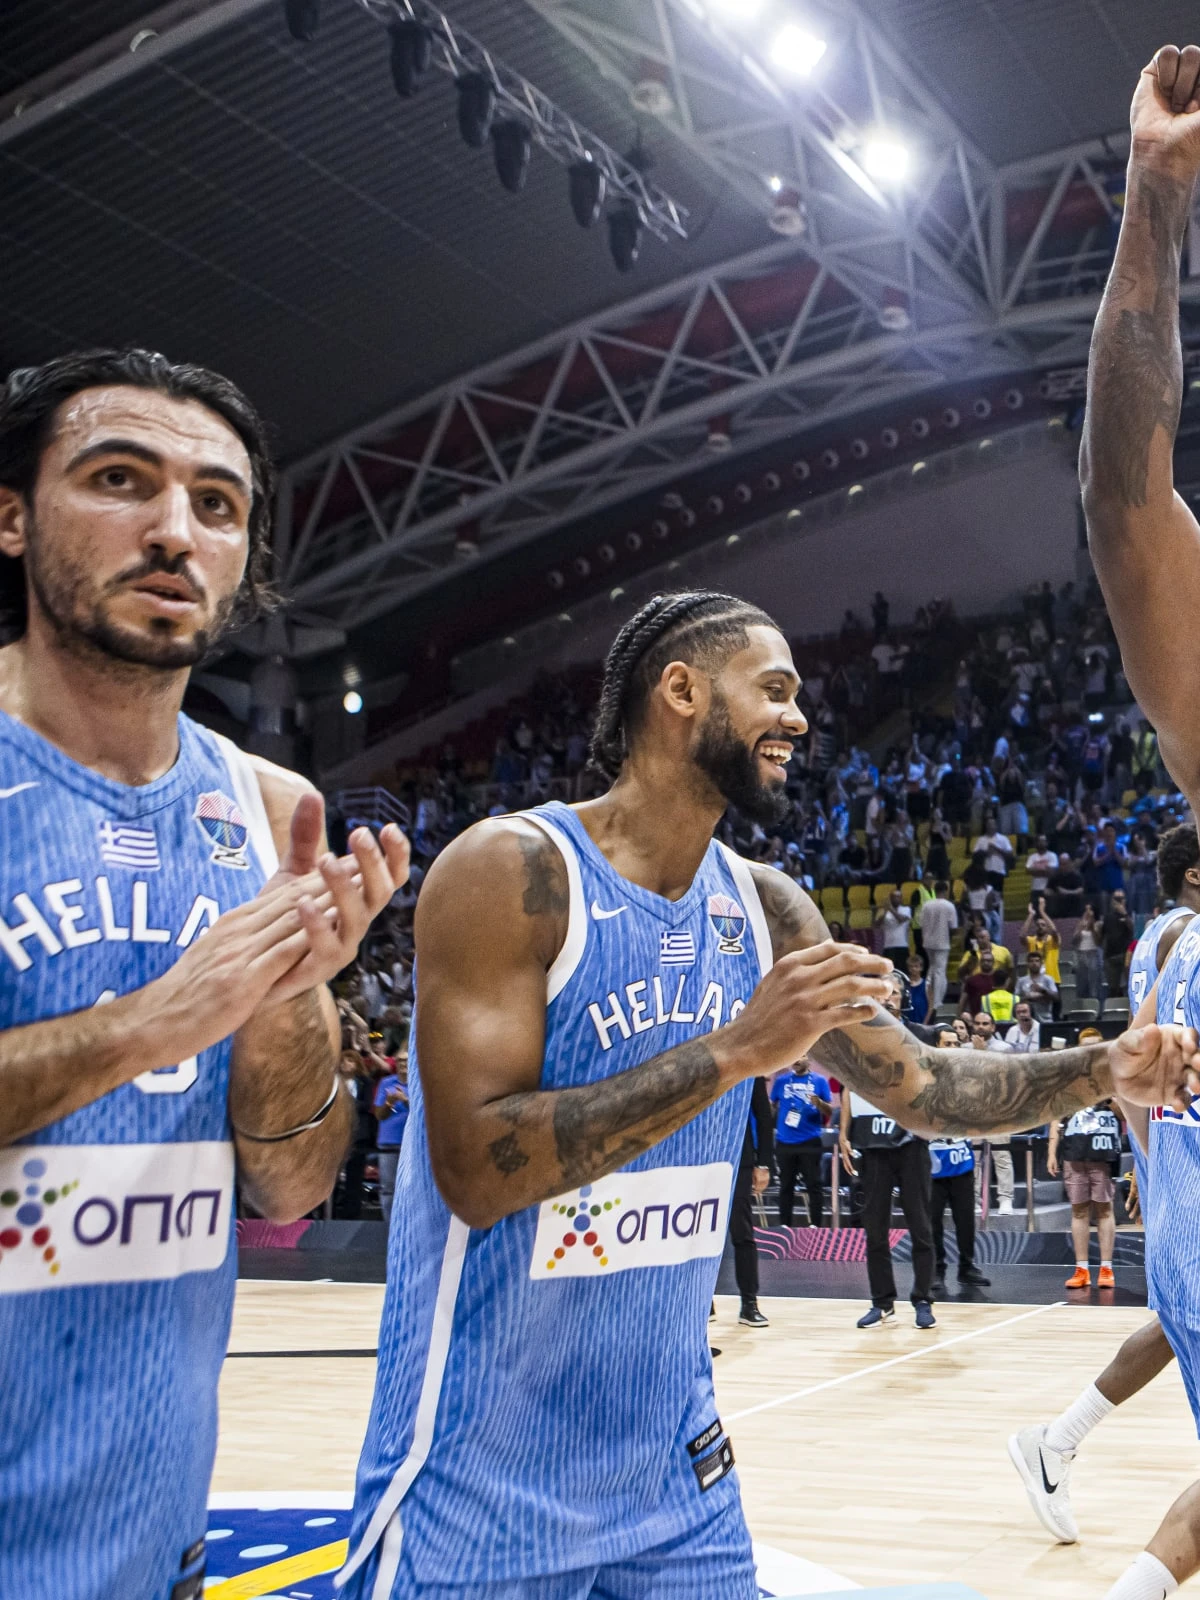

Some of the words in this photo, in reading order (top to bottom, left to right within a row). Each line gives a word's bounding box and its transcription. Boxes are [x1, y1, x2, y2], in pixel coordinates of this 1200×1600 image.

[0, 876, 221, 972] HELLA
[872, 1116, 896, 1135] 017
[1092, 1134, 1113, 1150] 001
